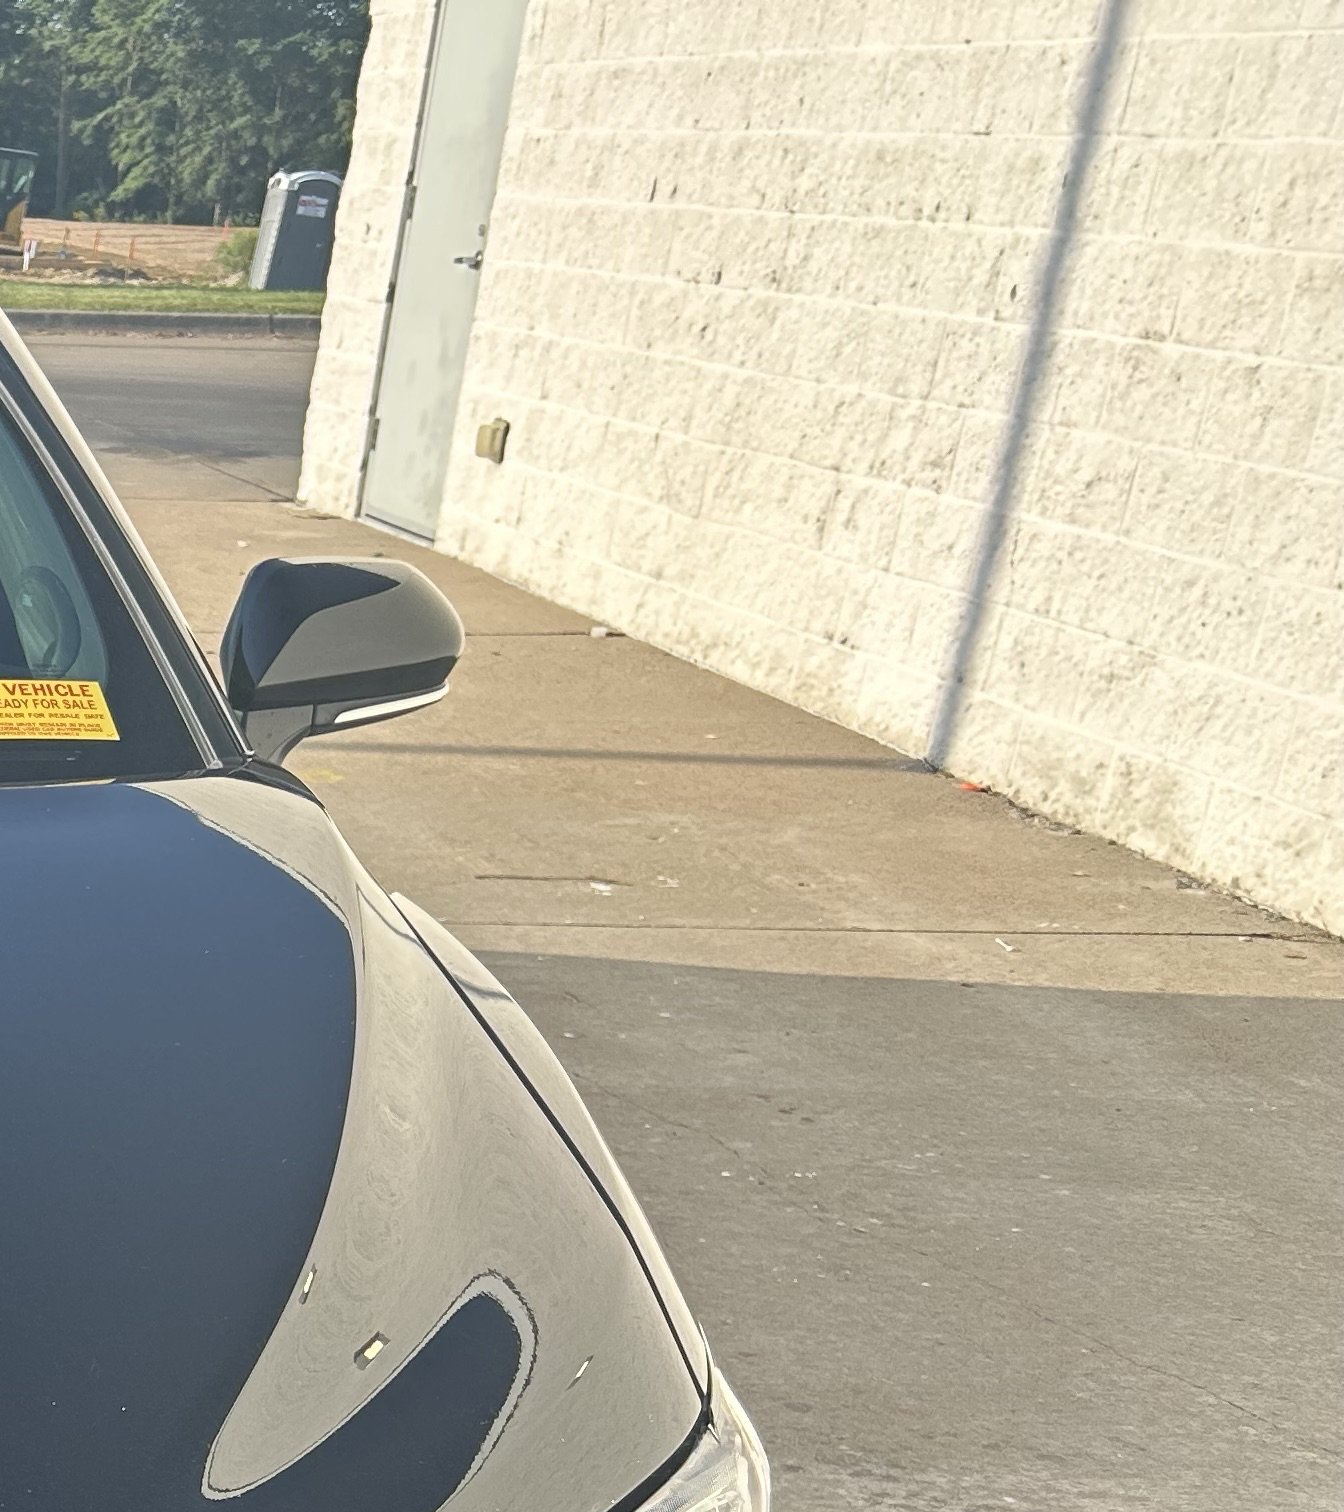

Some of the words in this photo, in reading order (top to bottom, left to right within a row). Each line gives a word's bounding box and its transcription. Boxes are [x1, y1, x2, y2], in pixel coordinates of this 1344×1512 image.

[2, 683, 94, 698] VEHICLE
[33, 699, 60, 710] FOR
[63, 700, 97, 710] SALE
